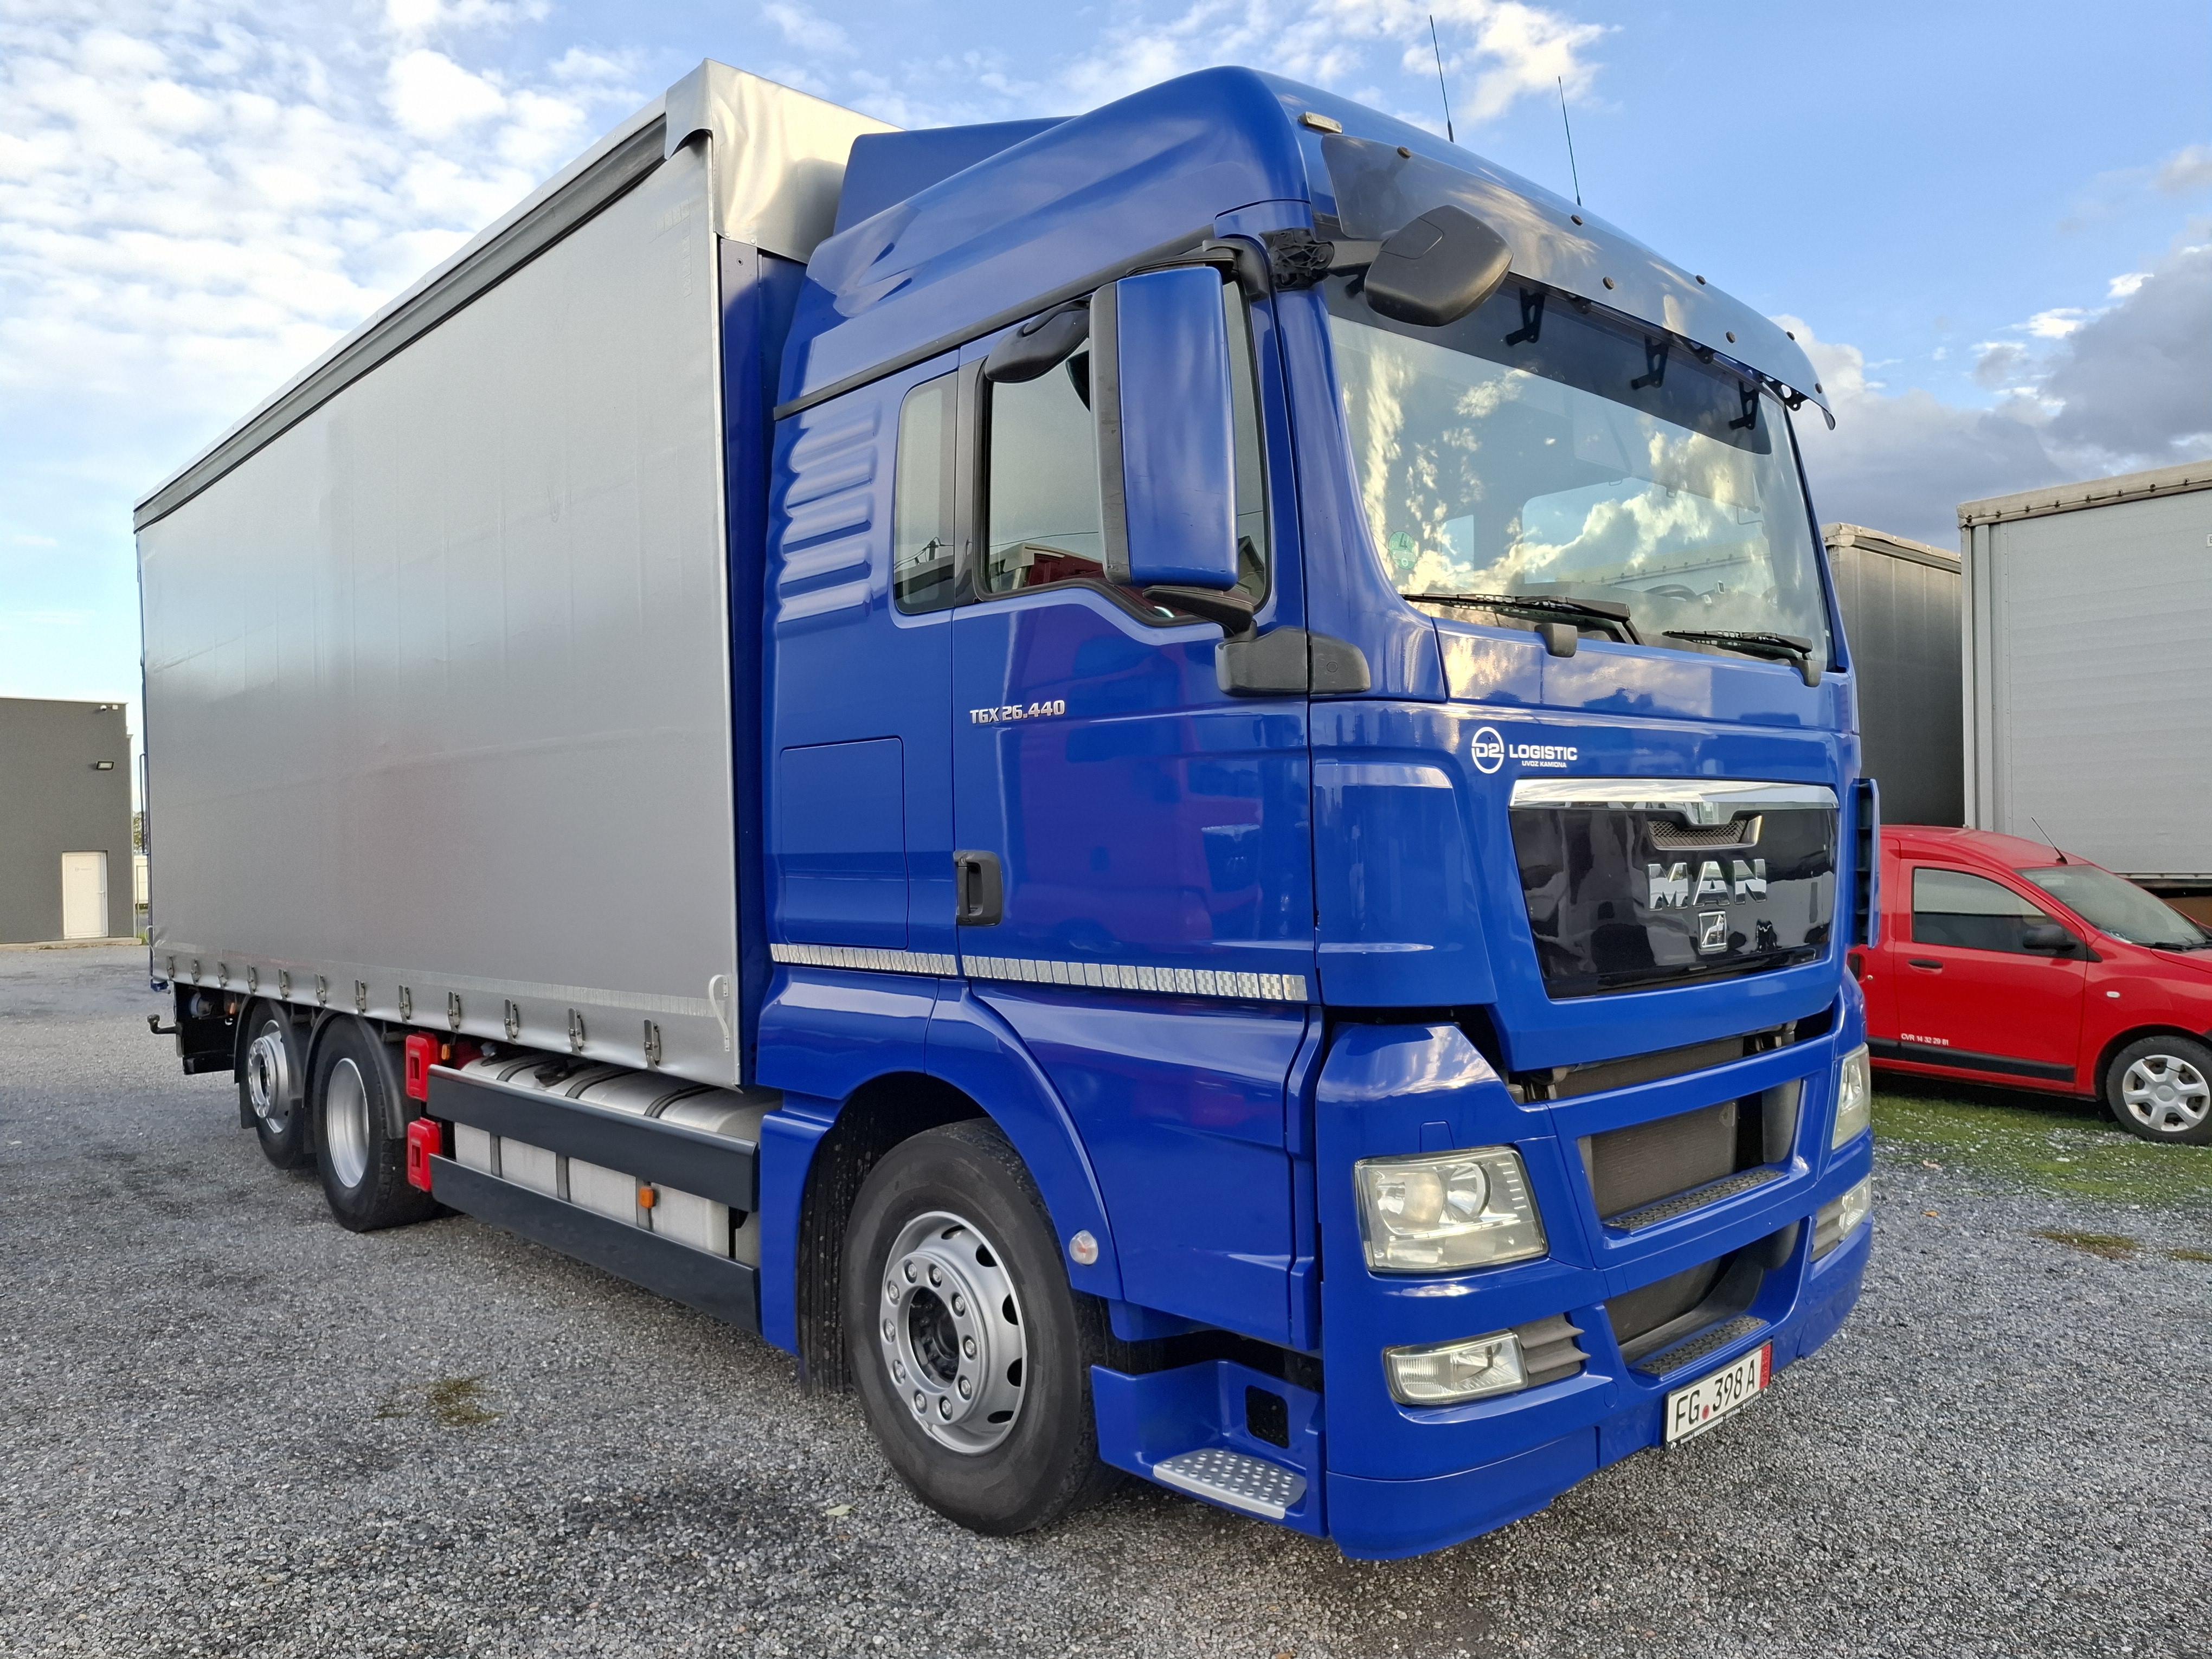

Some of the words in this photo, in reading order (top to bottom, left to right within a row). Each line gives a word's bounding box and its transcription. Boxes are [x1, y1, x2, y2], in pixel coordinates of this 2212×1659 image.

[969, 707, 1000, 724] TGX
[1002, 700, 1065, 721] 26.440
[1509, 744, 1578, 761] LOGISTIC
[1647, 859, 1767, 911] MAN
[1901, 1033, 1915, 1041] CVR
[1675, 1389, 1700, 1433] FG
[1712, 1366, 1743, 1412] 398
[1746, 1359, 1755, 1393] A
